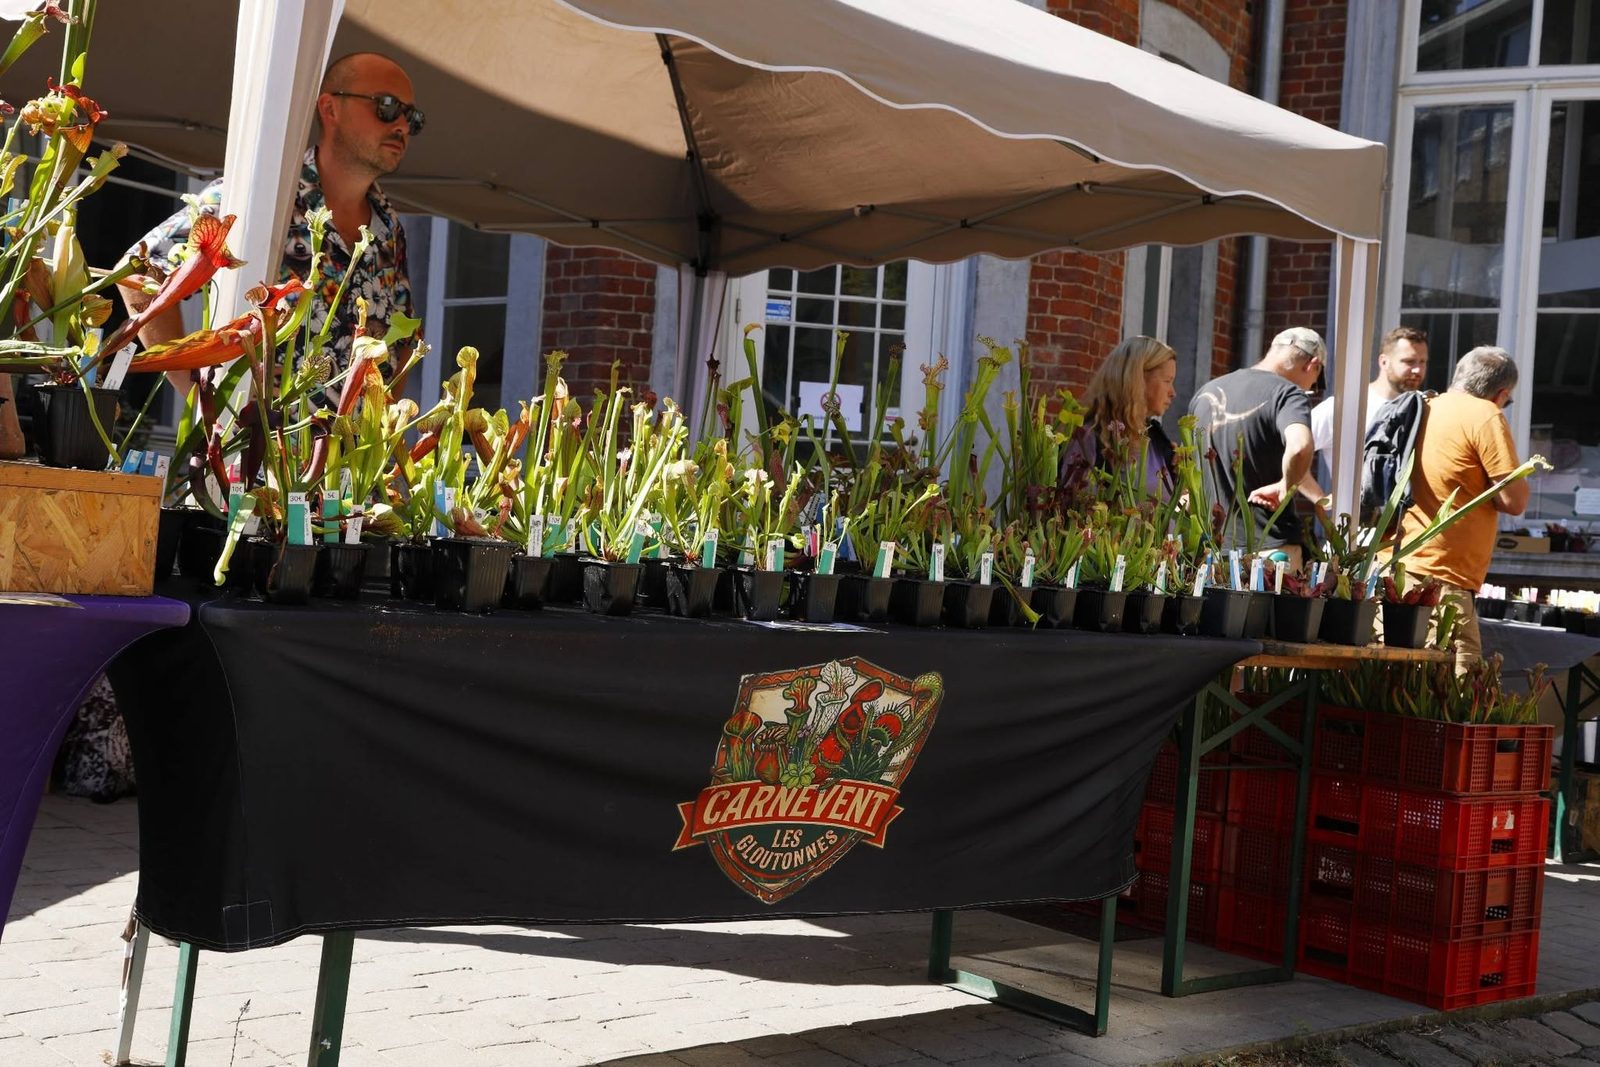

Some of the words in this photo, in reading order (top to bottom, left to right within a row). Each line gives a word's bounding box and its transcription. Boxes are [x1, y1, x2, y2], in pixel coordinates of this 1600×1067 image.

[703, 784, 890, 828] CARNEVENT
[736, 829, 840, 871] GLOUTONNES
[771, 828, 803, 849] LES
